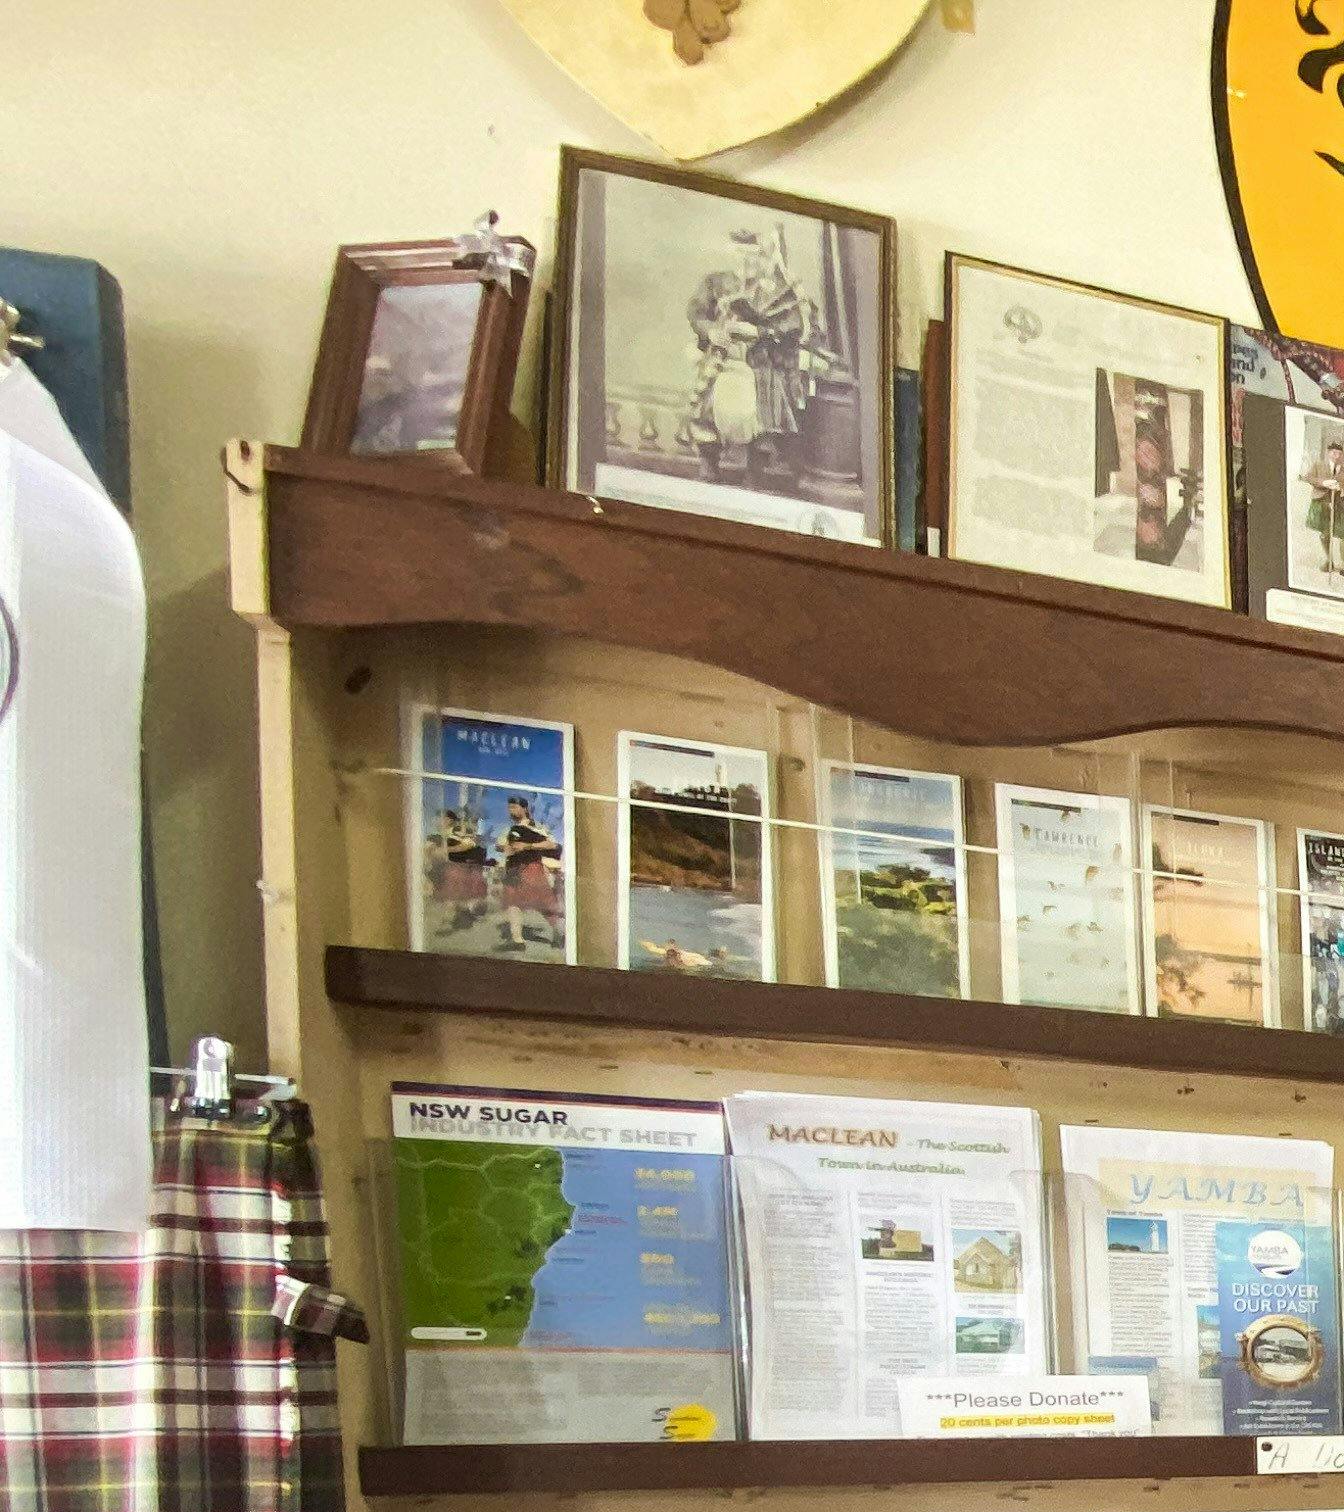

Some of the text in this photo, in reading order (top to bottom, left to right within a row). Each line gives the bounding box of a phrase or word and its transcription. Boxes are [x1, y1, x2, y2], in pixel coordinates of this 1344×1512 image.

[410, 1102, 568, 1126] NSW SUGAR
[410, 1119, 698, 1147] INDUSTRY FACT SHEET
[768, 1123, 898, 1148] MACLEAN
[1131, 1173, 1303, 1207] YAMBA
[1232, 1282, 1319, 1298] DISCOVER
[1233, 1299, 1319, 1314] OUR PAST
[1268, 1441, 1289, 1469] A
